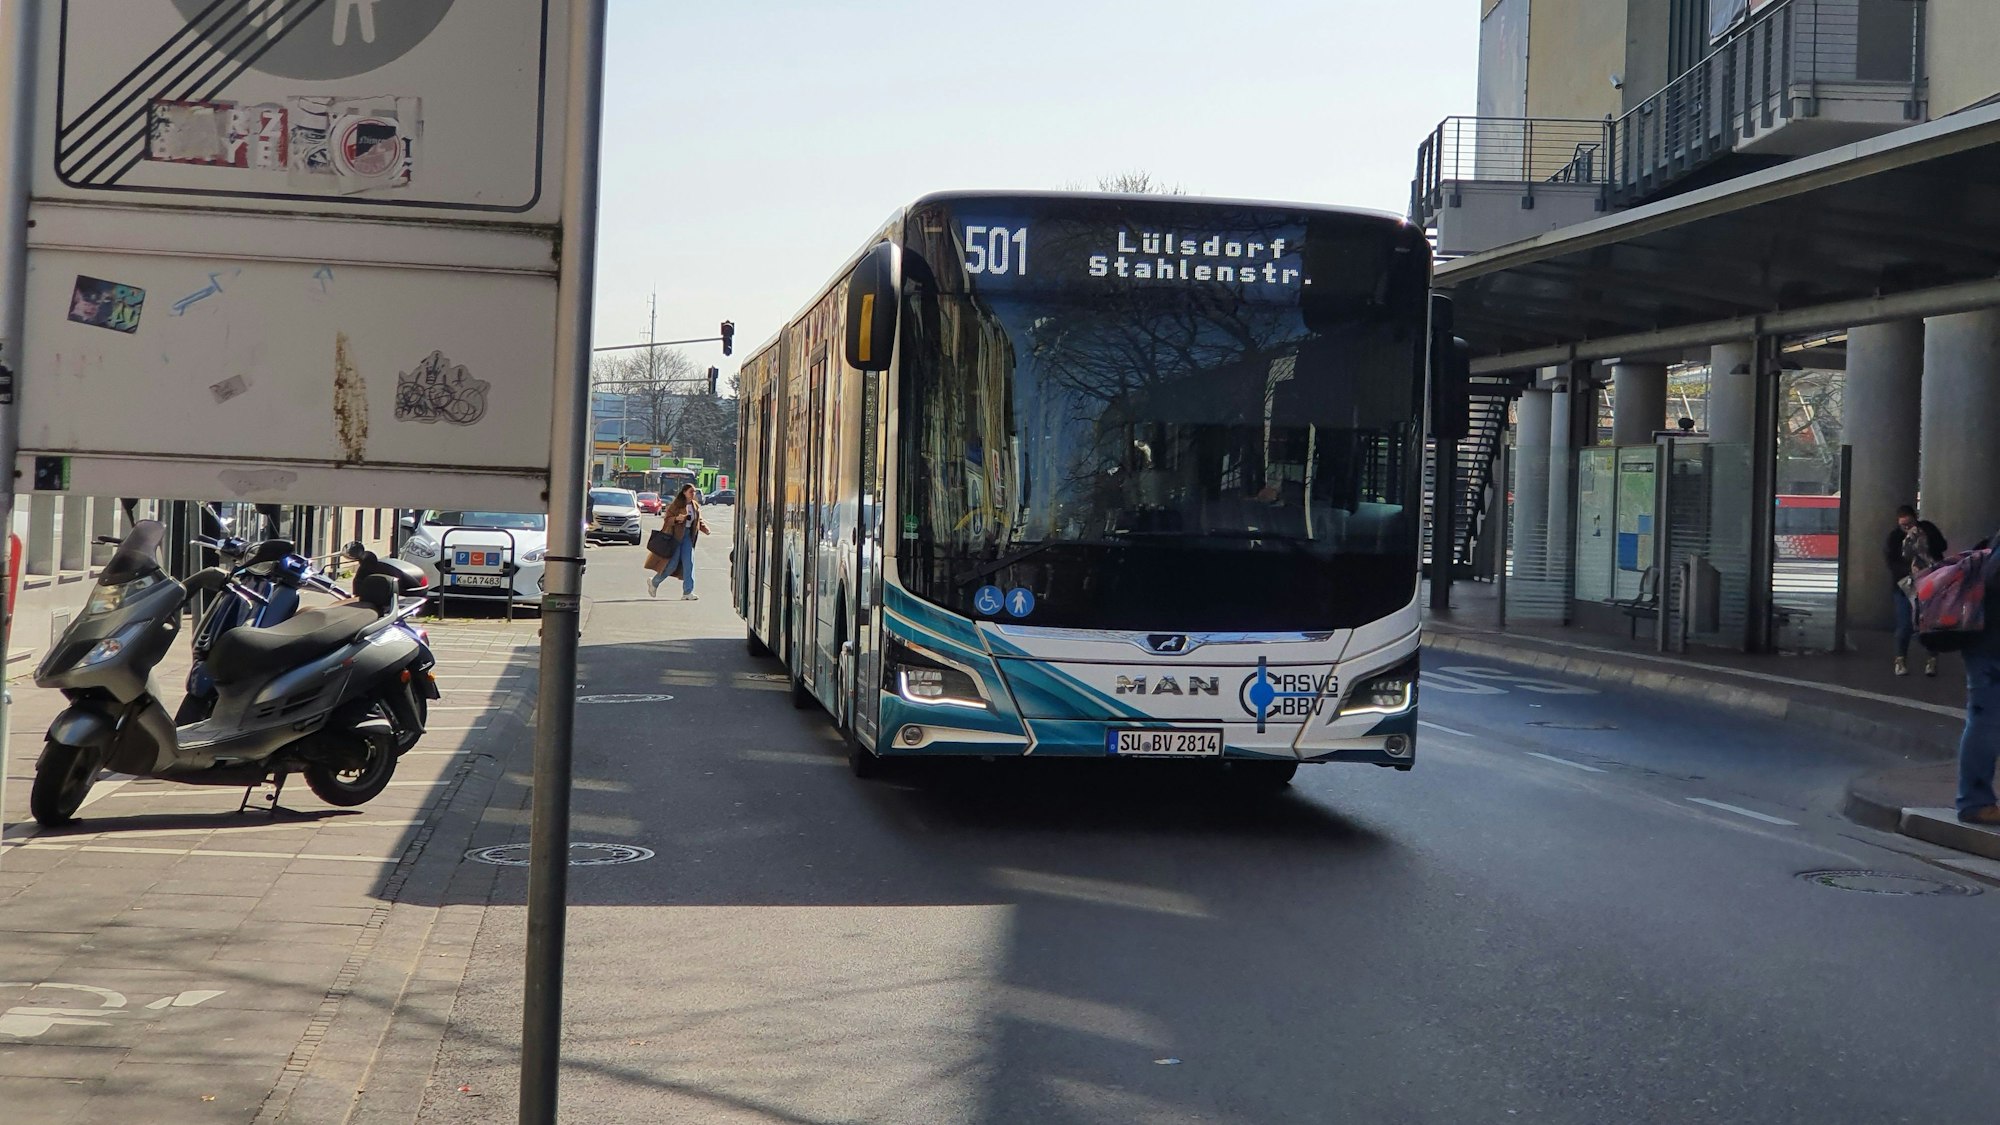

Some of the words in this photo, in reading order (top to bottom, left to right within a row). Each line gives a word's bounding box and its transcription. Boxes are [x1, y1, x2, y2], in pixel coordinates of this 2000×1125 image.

[965, 225, 1027, 275] 501
[1118, 231, 1285, 258] Lülsdorf
[1089, 255, 1312, 284] Stahlenstr.
[1115, 674, 1220, 696] MAN
[1283, 674, 1338, 693] RSVG
[1283, 698, 1325, 716] BBV
[1120, 733, 1141, 751] SU
[1152, 734, 1174, 751] BV
[1177, 734, 1217, 752] 2814
